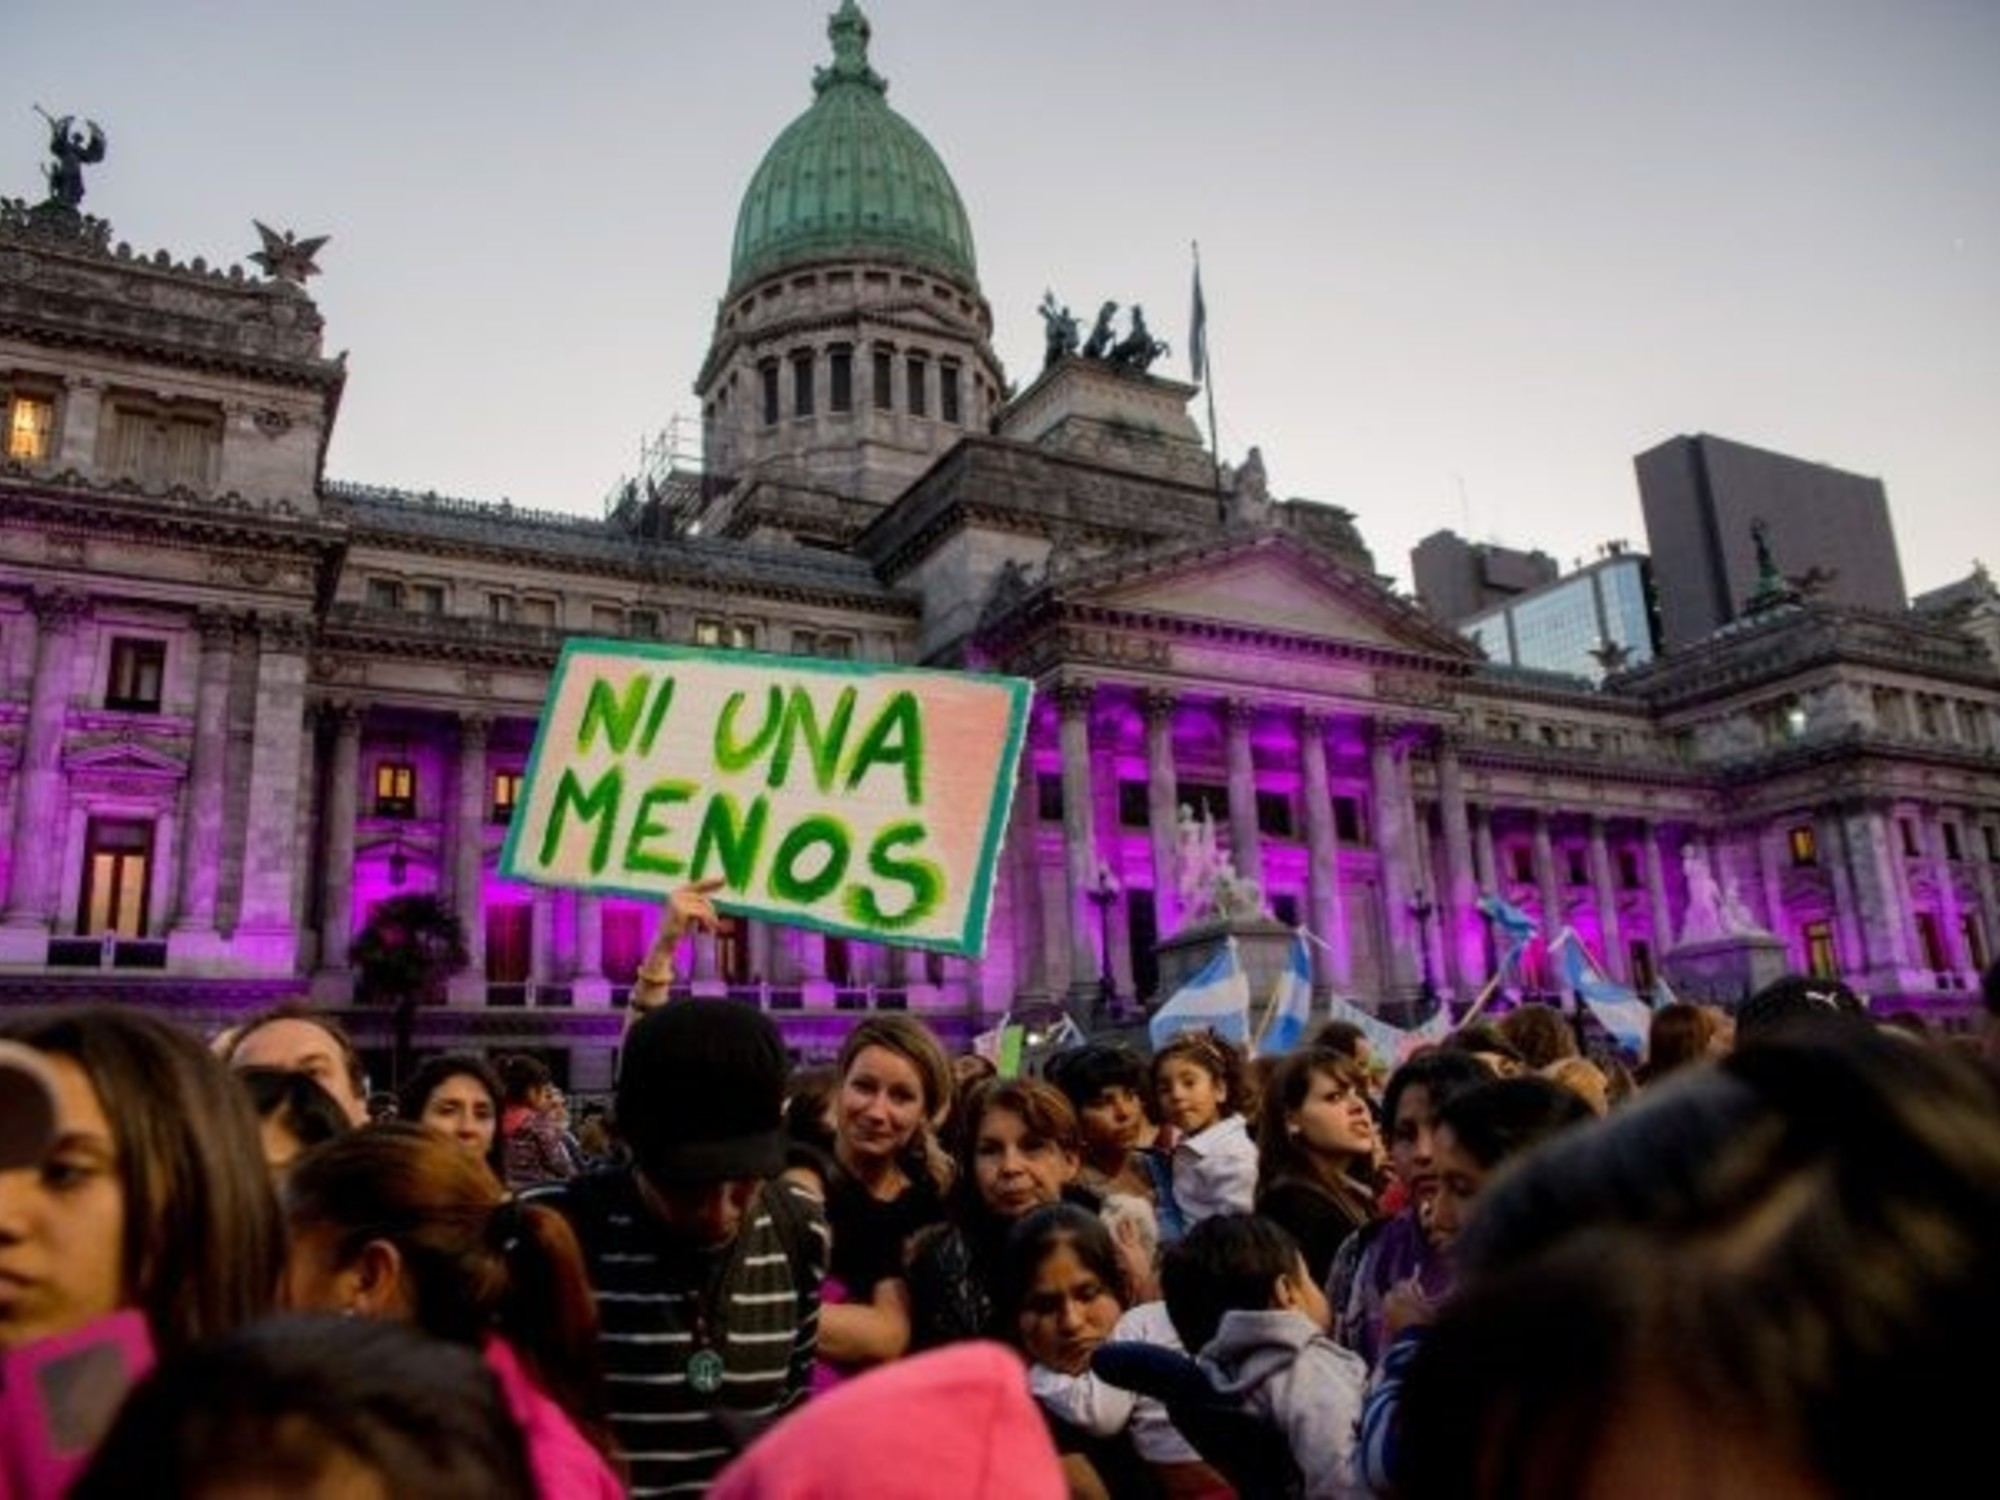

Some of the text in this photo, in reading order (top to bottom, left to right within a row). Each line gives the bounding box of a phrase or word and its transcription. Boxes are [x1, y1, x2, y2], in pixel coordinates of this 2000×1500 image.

[578, 673, 924, 805] NI UNA
[540, 765, 944, 925] MENOS
